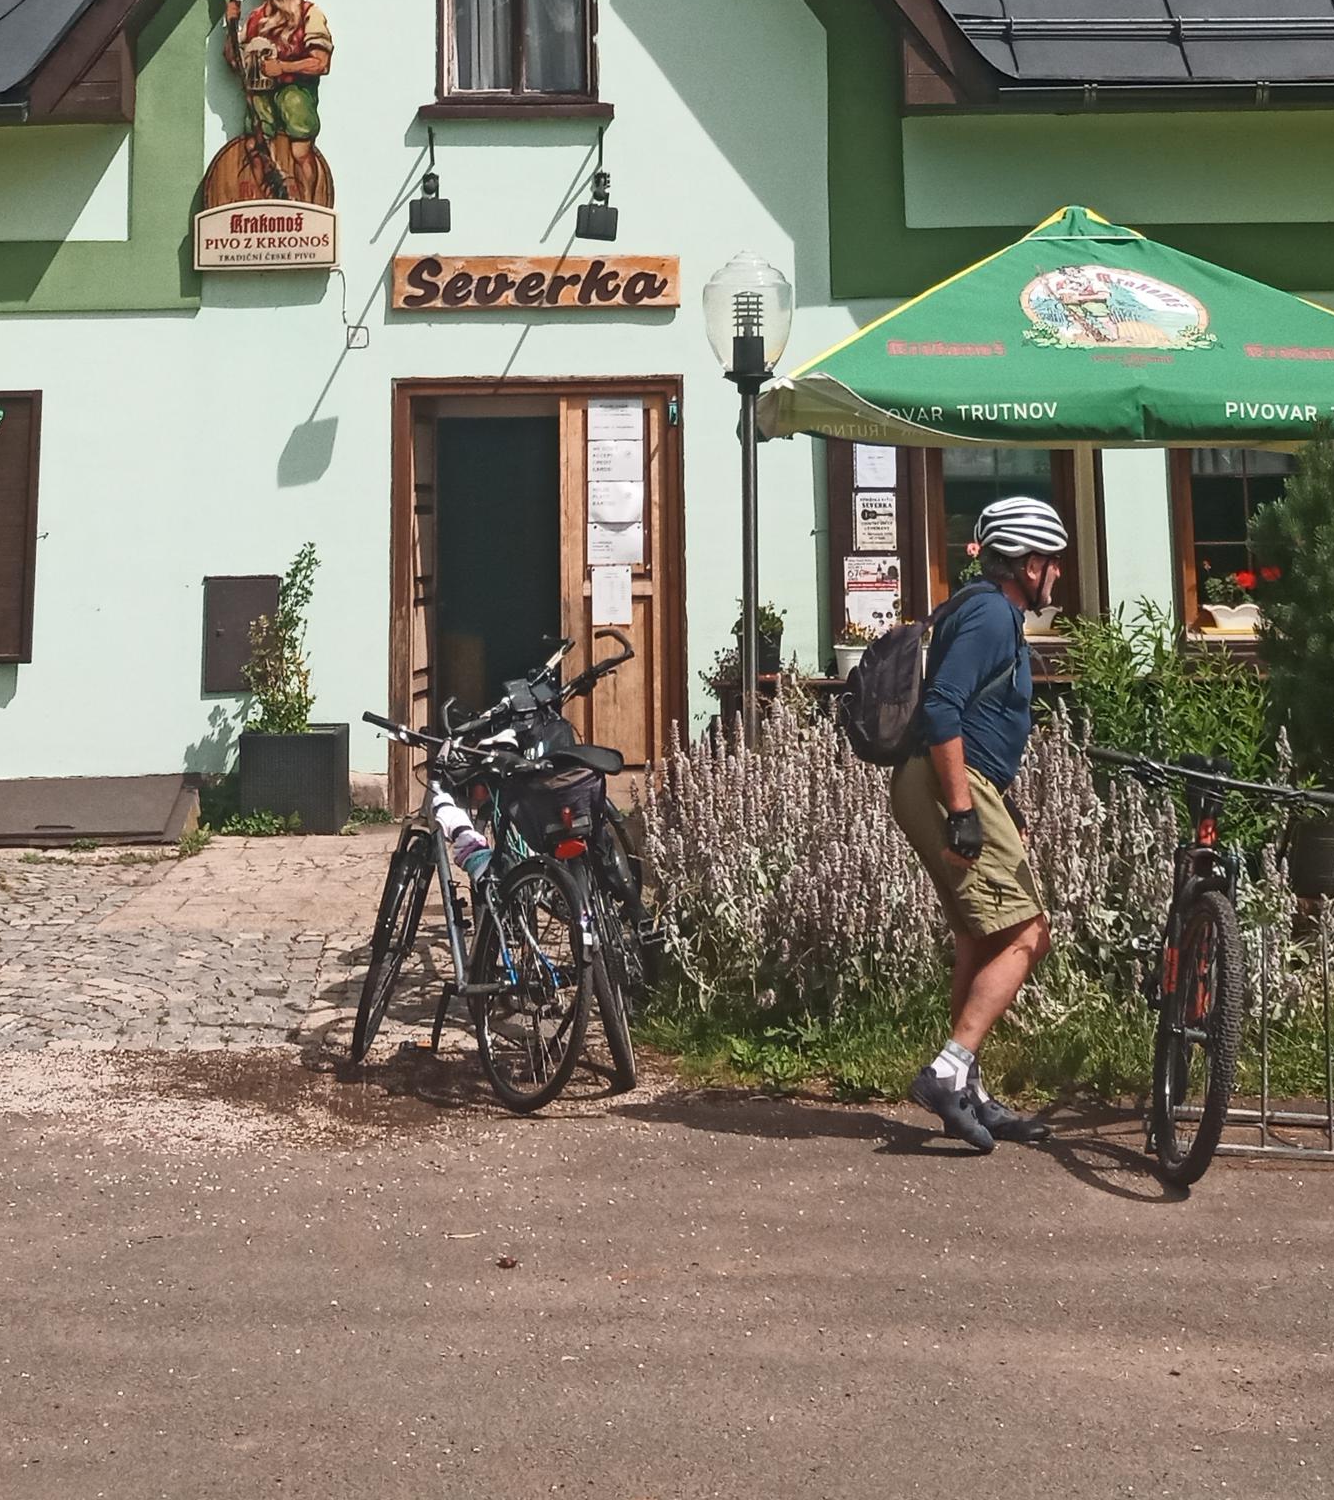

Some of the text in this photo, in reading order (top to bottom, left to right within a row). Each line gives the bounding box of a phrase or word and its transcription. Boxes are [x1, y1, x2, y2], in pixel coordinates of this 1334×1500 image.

[230, 213, 304, 234] Krakonoš
[205, 234, 329, 250] PIVO Z KRKONOŠ
[219, 252, 262, 261] TRADIČNÍ
[294, 252, 316, 260] PIVO
[403, 257, 668, 307] Severka
[886, 402, 1058, 422] OVAR TRUTNOV
[1225, 402, 1318, 421] PIVOVAR
